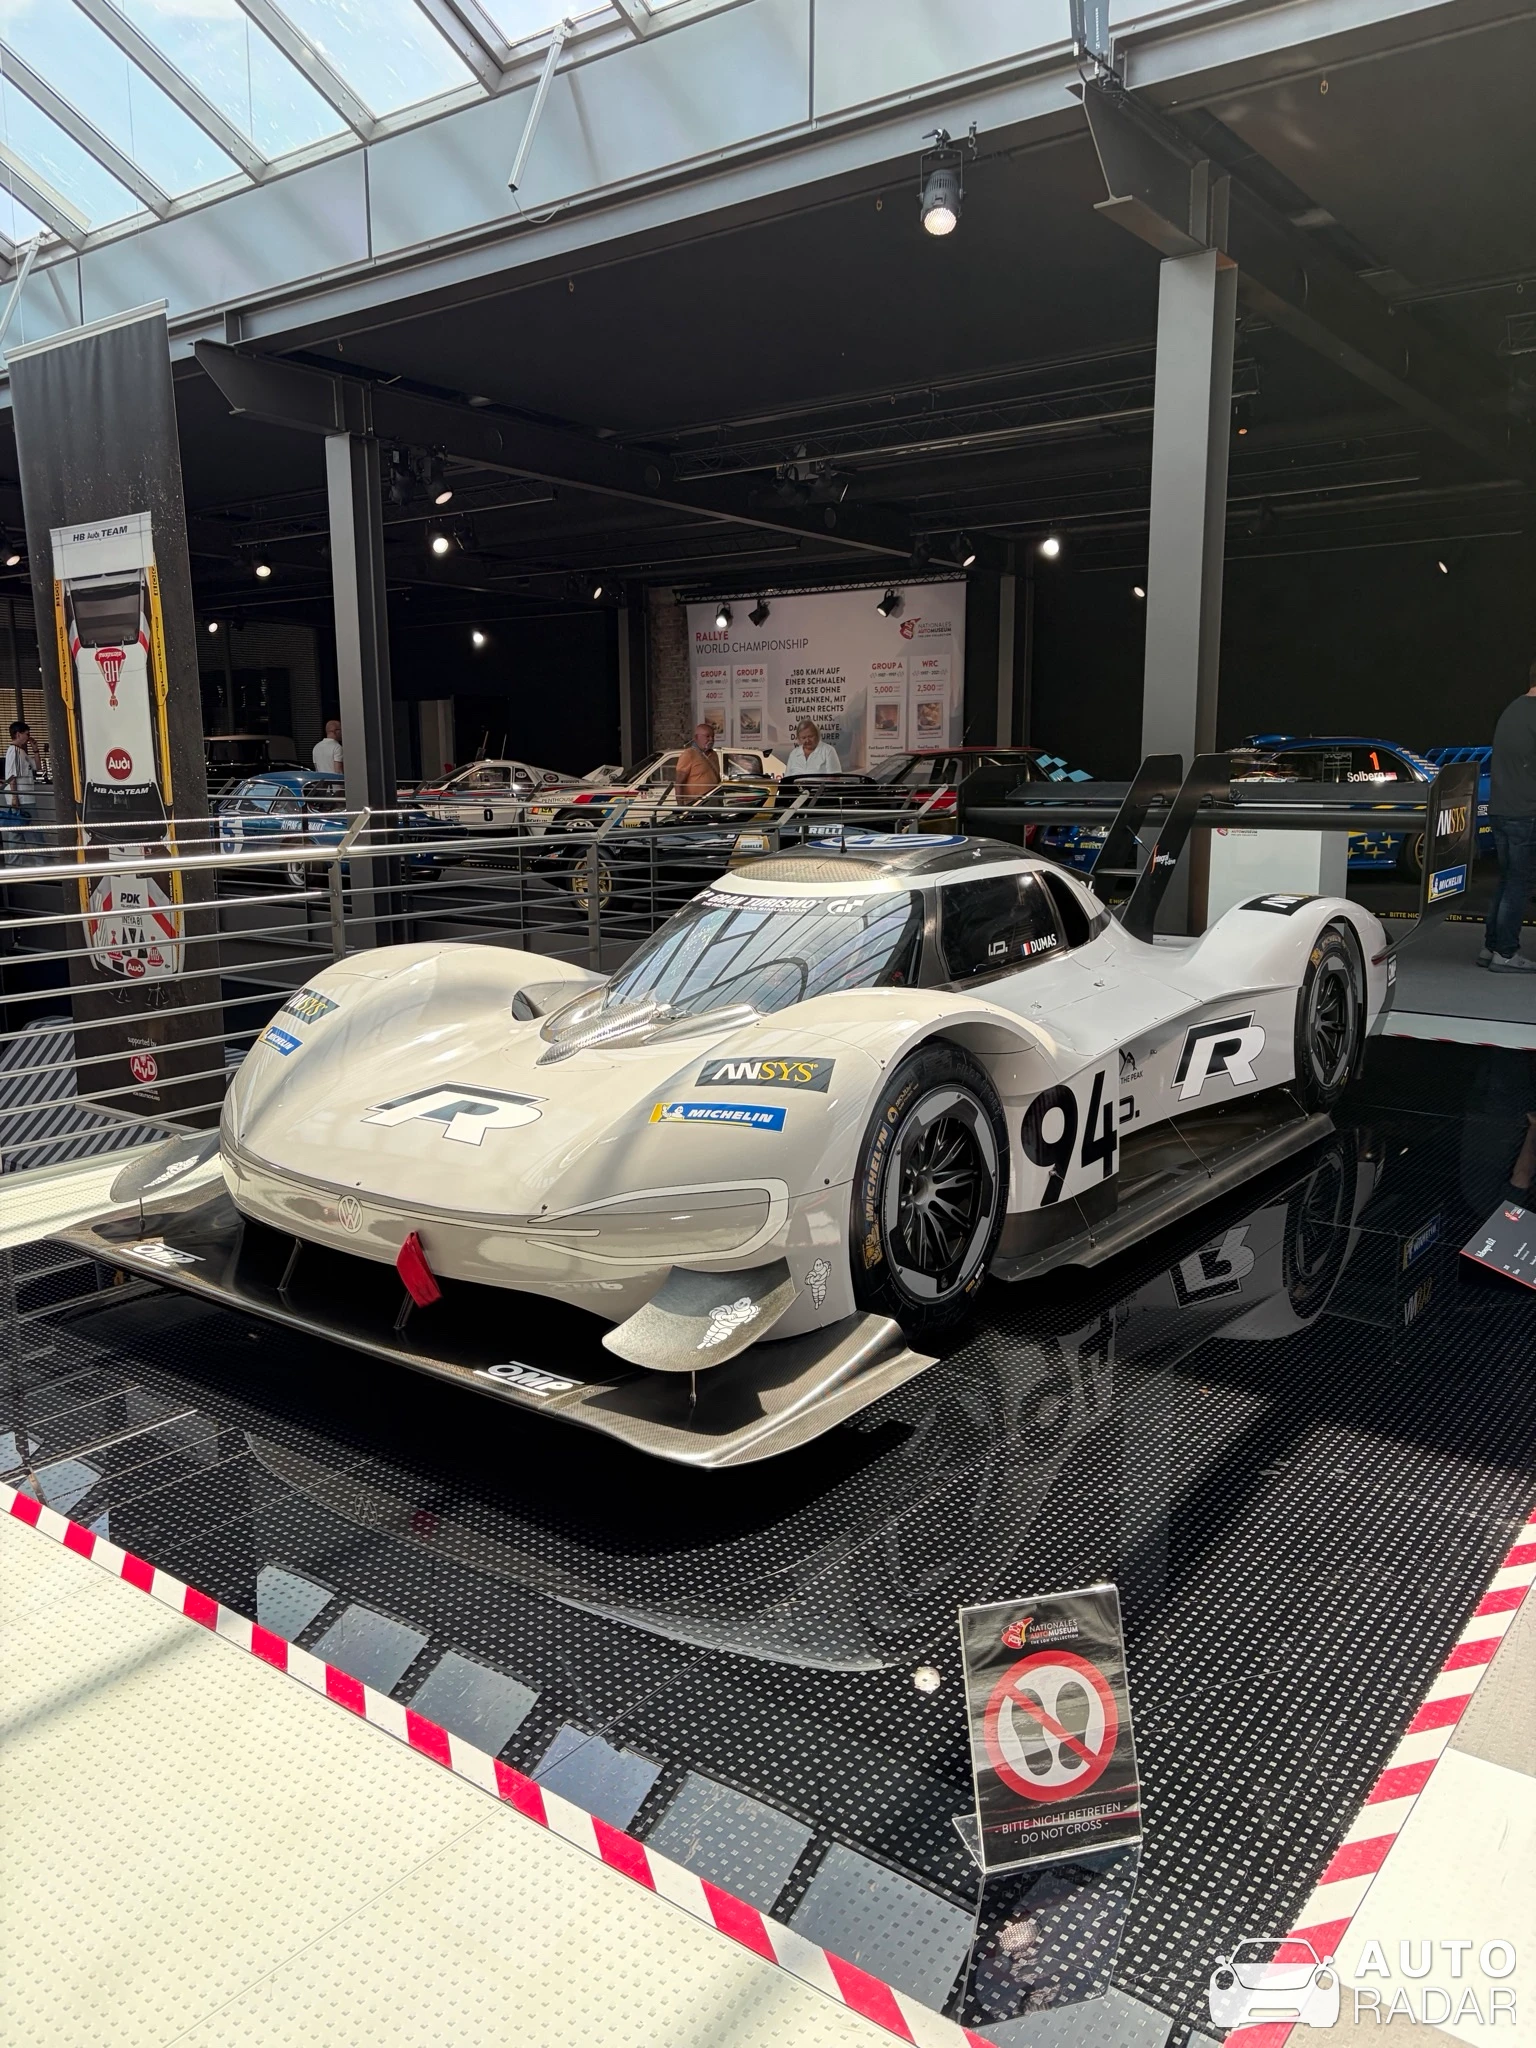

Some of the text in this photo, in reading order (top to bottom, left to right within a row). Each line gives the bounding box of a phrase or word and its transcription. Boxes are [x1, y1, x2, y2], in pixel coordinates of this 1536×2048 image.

[73, 525, 128, 542] HB Audi TEAM
[918, 621, 952, 629] NATIONALES
[696, 631, 729, 642] RALLYE
[696, 638, 809, 655] WORLD CHAMPIONSHIP
[871, 661, 903, 670] GROUP A
[921, 660, 939, 668] WRC
[103, 661, 120, 683] HB
[701, 670, 722, 678] GROUP
[736, 669, 758, 677] GROUP
[805, 667, 825, 676] KM/H
[826, 667, 840, 675] AUF
[785, 676, 846, 686] EINER SCHMALEN
[789, 686, 841, 695] STRASSE OHNE
[874, 685, 893, 694] 5,000
[917, 684, 936, 692] 2,500
[784, 695, 847, 705] LEITPLANKEN, MIT
[786, 704, 844, 714] BÄUMEN RECHTS
[812, 714, 835, 722] LINKS.
[108, 757, 130, 770] Audi
[1369, 751, 1380, 771] 1
[1347, 771, 1385, 783] Solberg
[125, 787, 149, 795] TEAM
[1436, 806, 1467, 837] ANSYS
[1438, 874, 1463, 890] MICHELIN
[120, 893, 141, 905] PDK
[707, 893, 749, 905] GRAN
[743, 897, 819, 909] TURISMO
[1030, 933, 1057, 954] DUMAS
[127, 963, 145, 973] Audi
[127, 1037, 157, 1048] supported by
[1170, 1009, 1266, 1102] R
[711, 1062, 819, 1083] ANSYS
[1120, 1070, 1144, 1085] THE PEAK
[687, 1109, 775, 1123] MICHELIN
[1020, 1070, 1118, 1207] 94
[866, 1127, 889, 1222] MICHELIN
[132, 1245, 196, 1264] OMP
[487, 1364, 574, 1391] OMP
[1029, 1619, 1078, 1633] NATIONALES
[1029, 1626, 1079, 1639] AUTOMUSEUM
[1050, 1634, 1079, 1642] COLLECTION
[1002, 1821, 1030, 1834] BITTE
[1032, 1812, 1066, 1827] NICHT
[1068, 1802, 1121, 1820] BETRETEN
[1021, 1832, 1039, 1845] DO
[1041, 1826, 1064, 1840] NOT
[1066, 1819, 1103, 1835] CROSS
